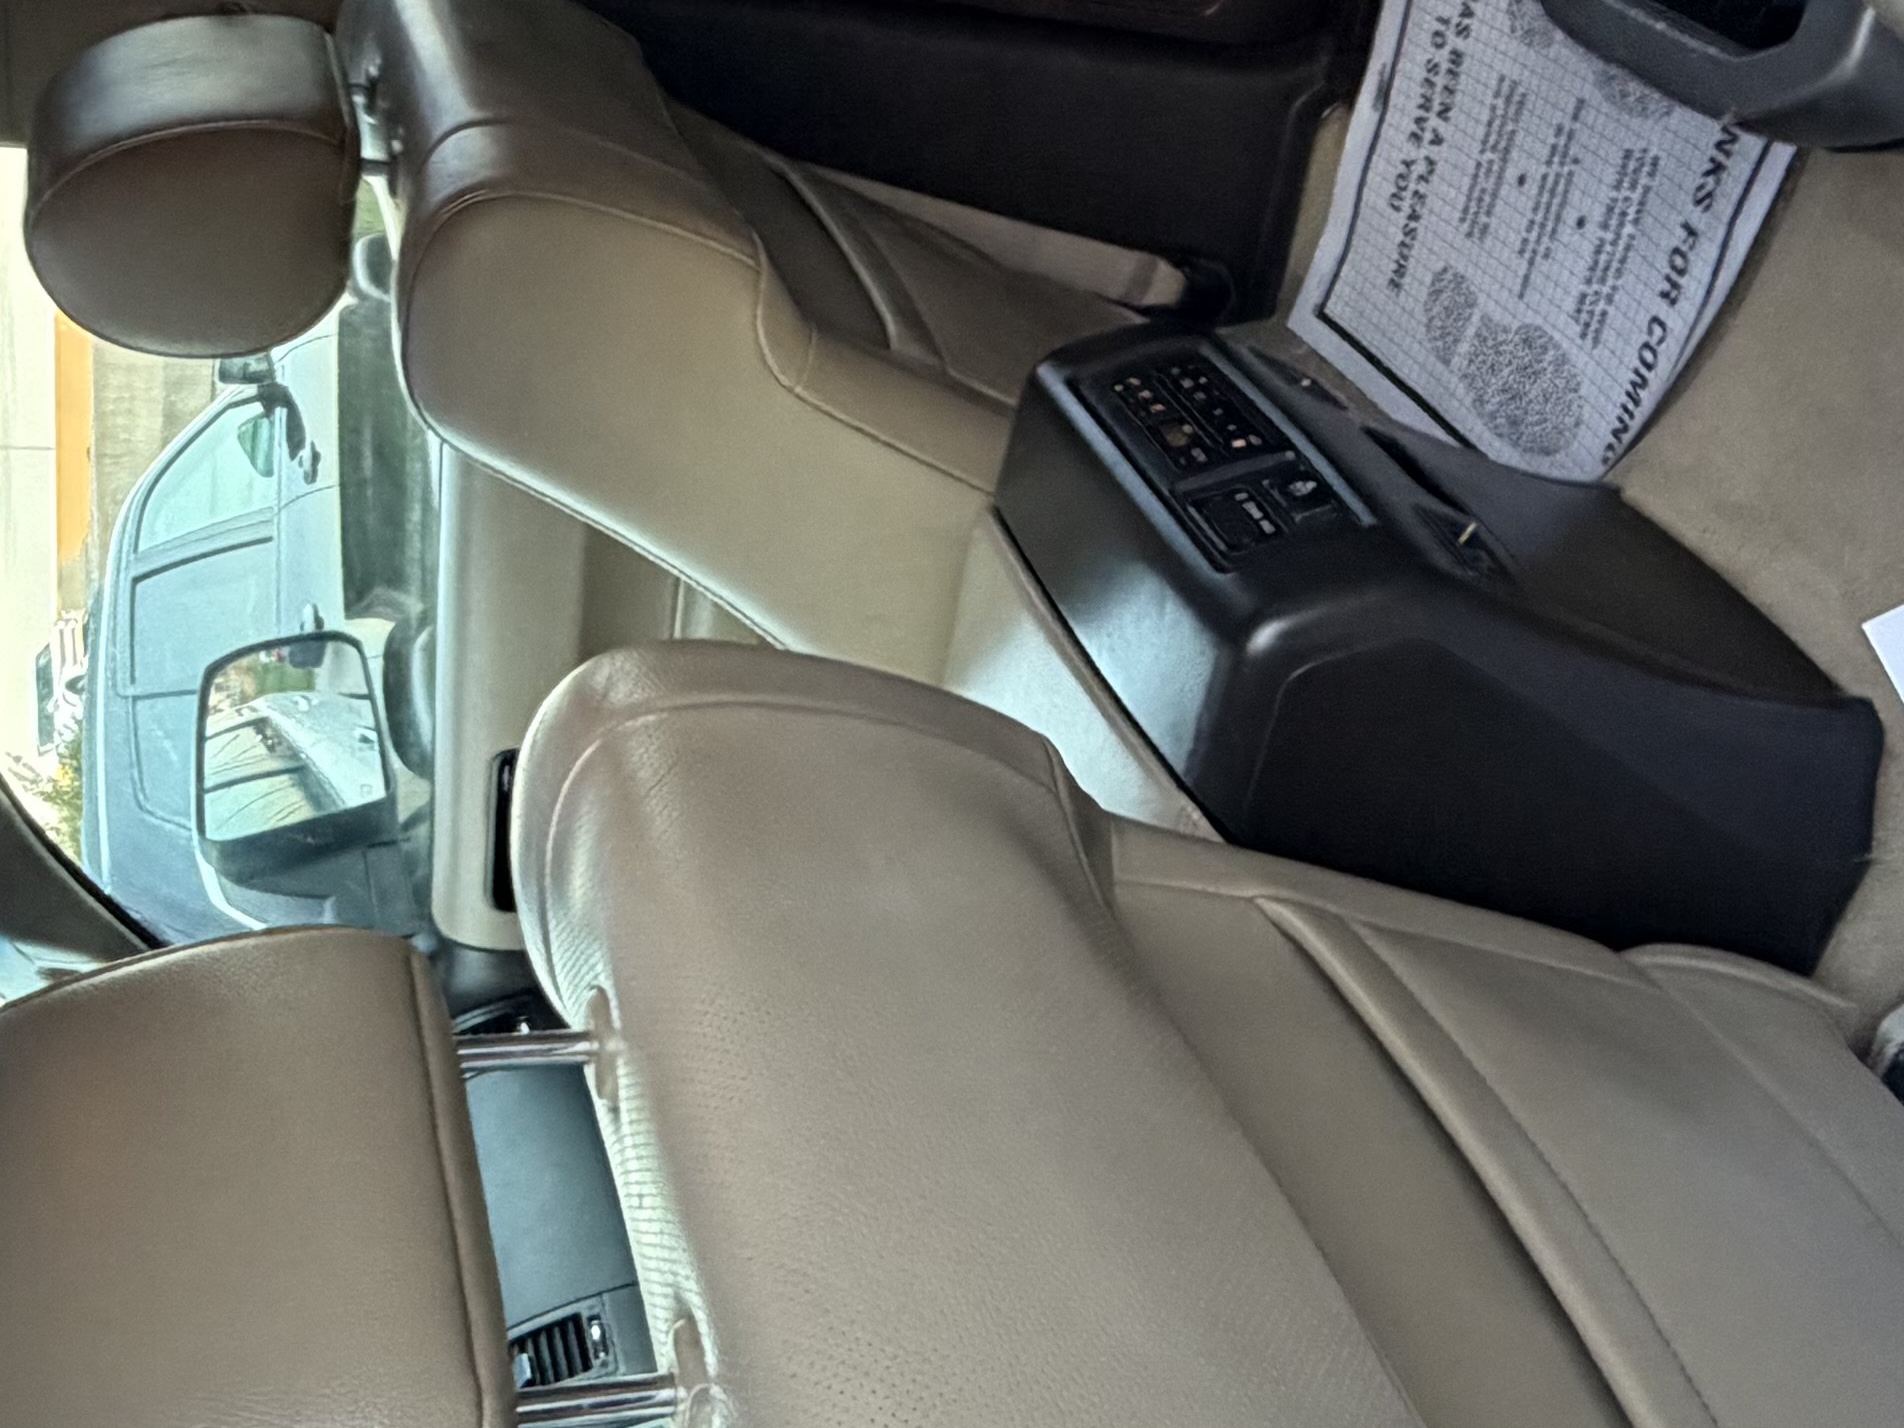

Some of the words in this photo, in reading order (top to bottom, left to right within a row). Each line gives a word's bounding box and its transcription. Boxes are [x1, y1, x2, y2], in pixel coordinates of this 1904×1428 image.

[1431, 15, 1452, 50] TO
[1407, 58, 1440, 148] SERVE
[1436, 48, 1465, 122] BEEN
[1428, 127, 1444, 146] A
[1693, 125, 1741, 213] NKS
[1389, 158, 1417, 213] YOU
[1387, 155, 1437, 298] PLEASURE
[1659, 220, 1699, 308] FOR
